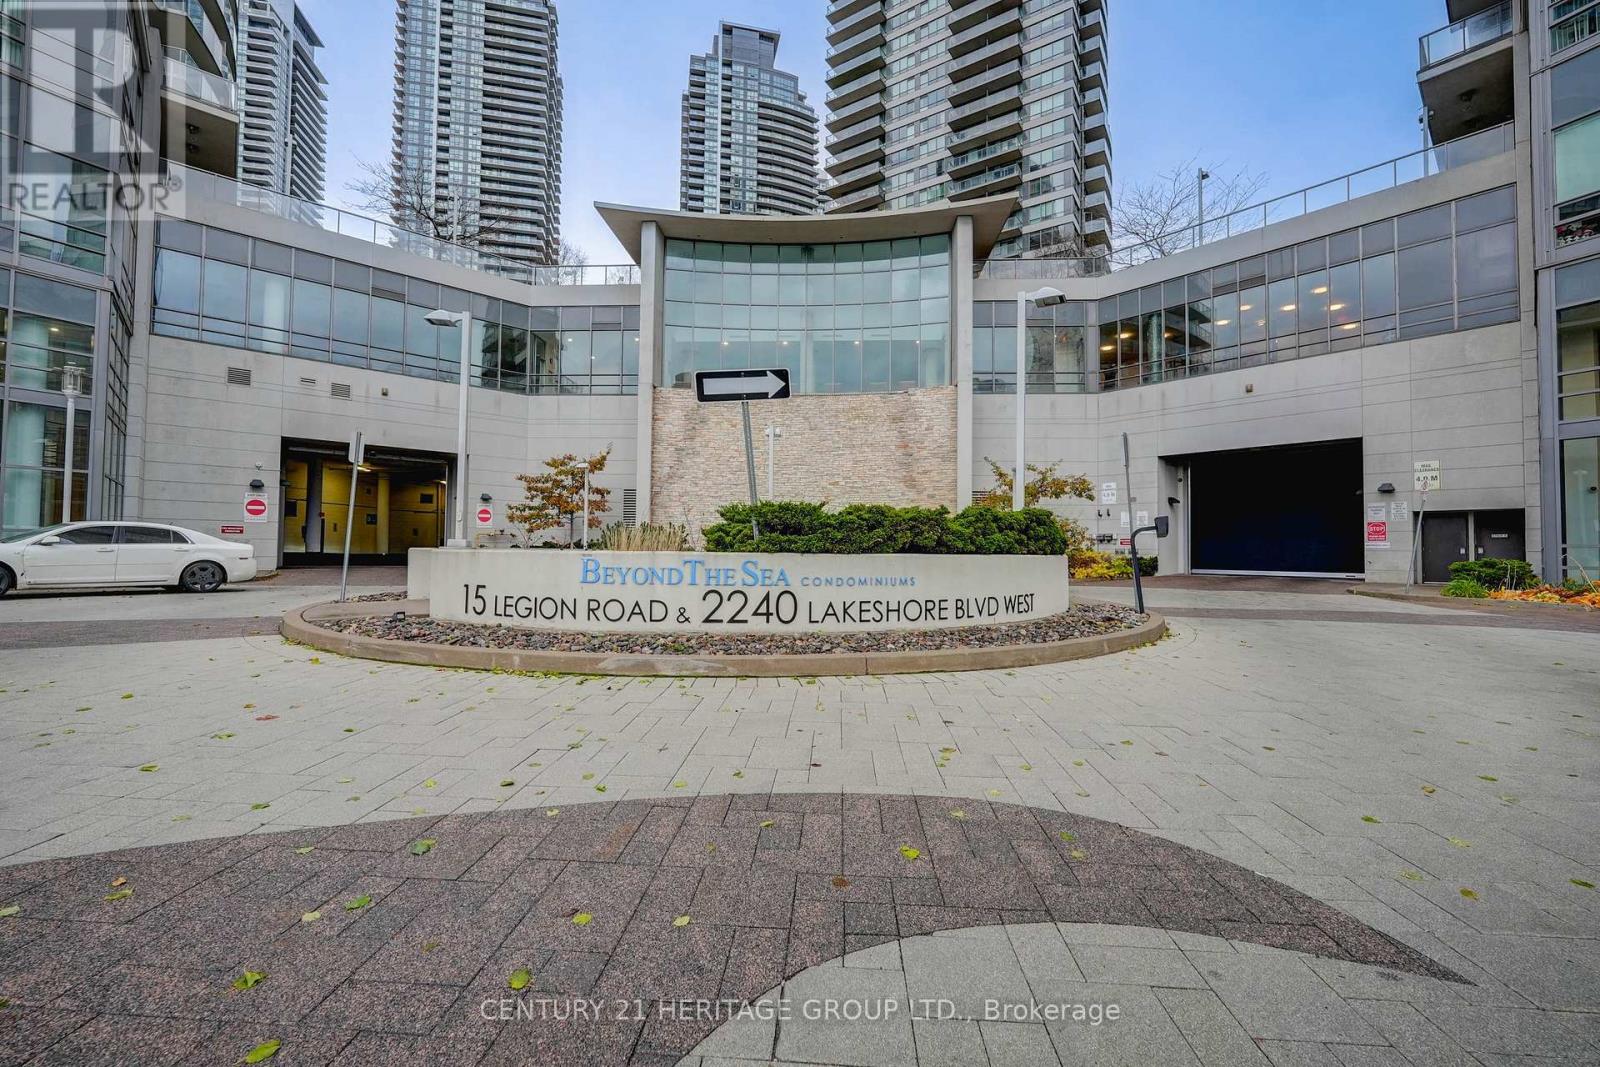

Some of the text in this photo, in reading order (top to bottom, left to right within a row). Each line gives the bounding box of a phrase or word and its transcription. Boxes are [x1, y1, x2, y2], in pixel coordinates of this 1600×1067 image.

[800, 576, 917, 588] CONDOMINIUMS
[463, 583, 1035, 624] 15 LEGION ROAD & 2240 LAKESHORE BLVD WEST
